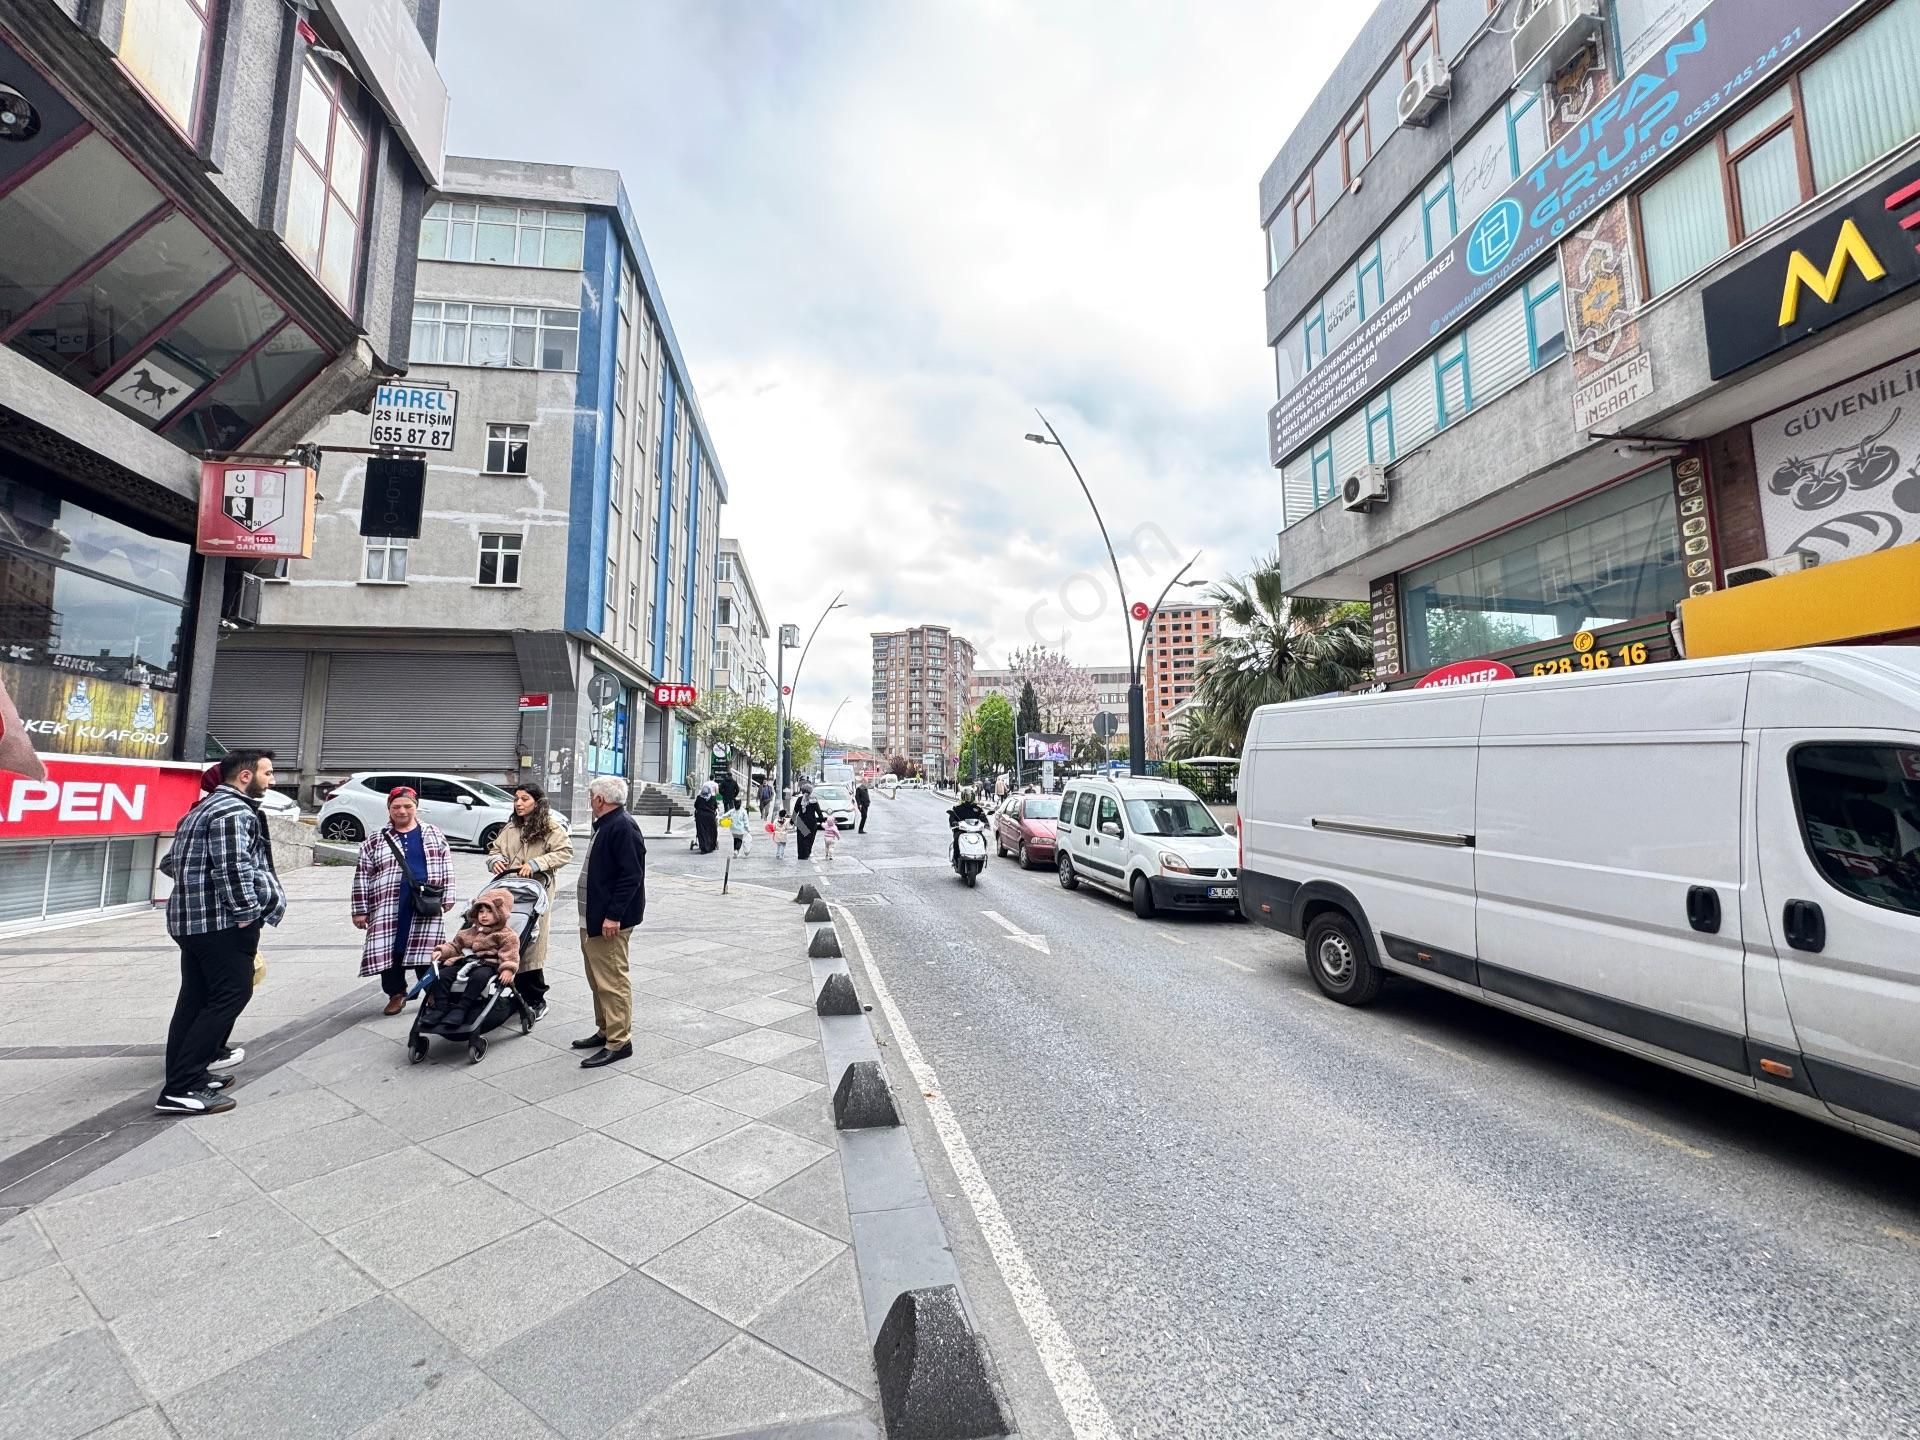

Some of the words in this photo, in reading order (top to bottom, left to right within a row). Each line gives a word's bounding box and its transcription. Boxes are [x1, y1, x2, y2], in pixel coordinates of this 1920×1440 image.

[1684, 95, 1721, 127] 0533
[1723, 68, 1753, 97] 745
[1756, 47, 1779, 70] 24
[1782, 26, 1802, 51] 21
[1526, 18, 1707, 192] TUFAN
[1529, 90, 1680, 229] GRUP
[1568, 192, 1596, 221] 0212
[1597, 175, 1618, 198] 651
[1622, 161, 1639, 179] 22
[1640, 145, 1657, 162] 88
[1441, 235, 1545, 323] www.tufangrup.com.tr
[1317, 333, 1365, 381] MÜHENDİSLİK
[1365, 291, 1412, 340] ARAŞTIRMA
[1413, 249, 1455, 297] MERKEZİ
[1326, 289, 1356, 324] HUZUR
[1327, 304, 1356, 333] GÜVEN
[1340, 341, 1375, 375] DANIŞMA
[1375, 305, 1411, 346] MERKEZİ
[378, 387, 447, 411] KAREL
[1575, 355, 1649, 409] AYDINLAR
[374, 426, 402, 443] 655
[407, 428, 427, 444] 87
[431, 430, 450, 447] 87
[375, 410, 392, 421] 2S
[395, 409, 452, 428] İLETİŞİM
[1532, 656, 1572, 677] 628
[1580, 650, 1610, 671] 96
[1619, 642, 1649, 666] 16
[658, 686, 692, 702] BİM
[76, 724, 170, 745] KUAFÖRÜ
[0, 779, 147, 822] PEN
